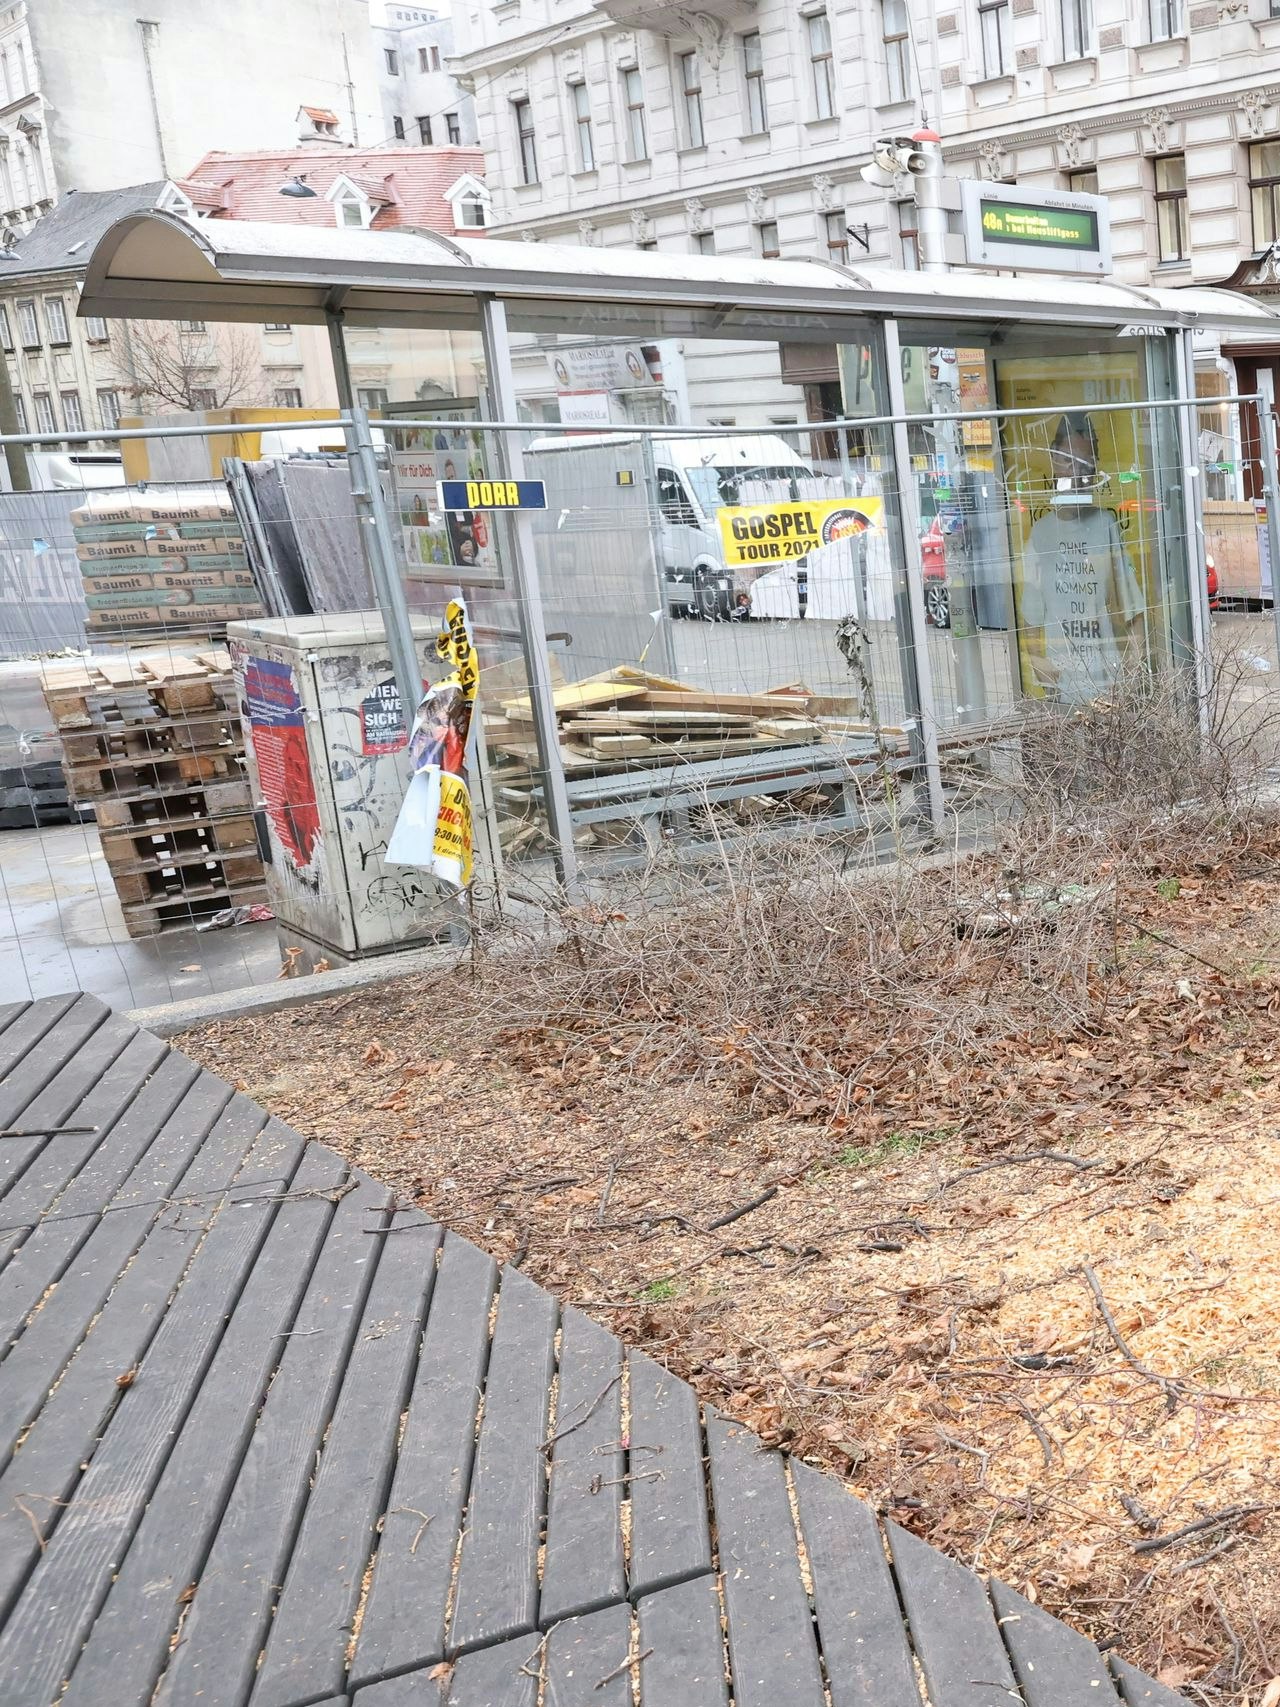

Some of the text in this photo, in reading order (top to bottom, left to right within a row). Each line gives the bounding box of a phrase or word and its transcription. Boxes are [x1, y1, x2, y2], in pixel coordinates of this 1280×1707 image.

[1044, 200, 1065, 208] Abfahrt
[1072, 202, 1093, 211] Minuten
[1083, 379, 1131, 403] BILLA
[82, 510, 131, 523] Baumit
[151, 509, 200, 520] Baumit
[731, 511, 818, 541] GOSPEL
[87, 543, 137, 556] Baumit
[158, 542, 206, 554] Baumit
[736, 538, 820, 561] TOUR 2021
[1059, 542, 1089, 556] OHNE
[1055, 560, 1096, 576] MATURA
[93, 578, 142, 590] Baumit
[165, 575, 214, 587] Baumit
[1055, 581, 1098, 596] KOMMST
[170, 608, 217, 620] Baumit
[1070, 601, 1086, 615] DU
[101, 610, 150, 623] Baumit
[1060, 619, 1102, 639] SEHR
[365, 712, 398, 727] SICH
